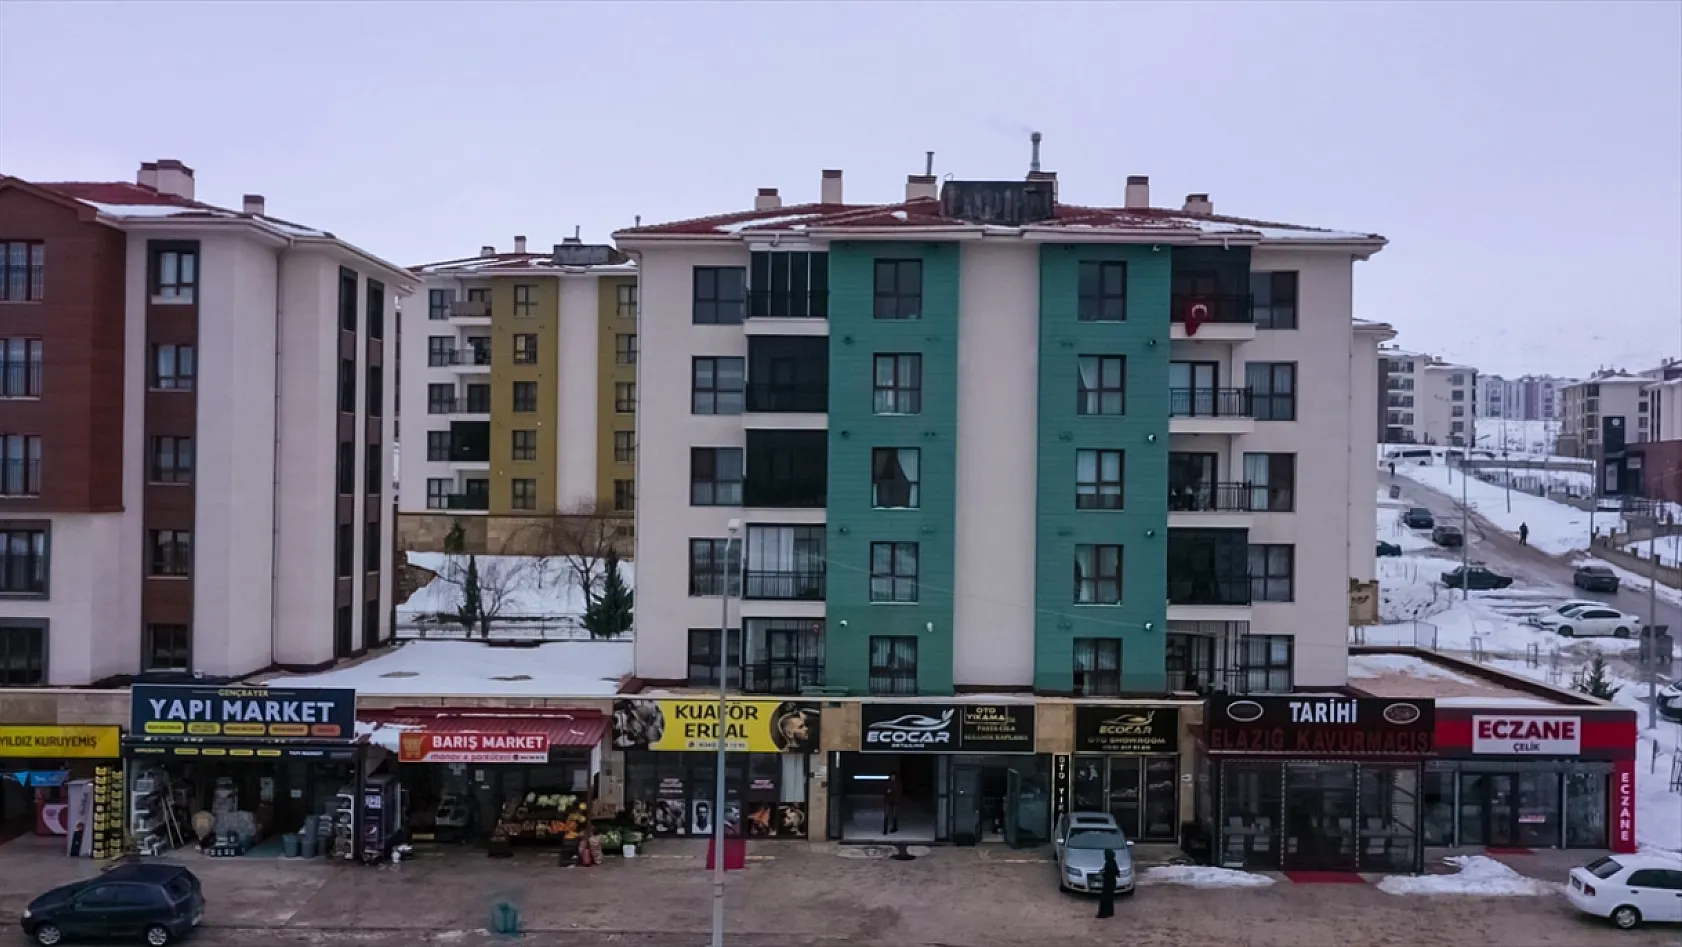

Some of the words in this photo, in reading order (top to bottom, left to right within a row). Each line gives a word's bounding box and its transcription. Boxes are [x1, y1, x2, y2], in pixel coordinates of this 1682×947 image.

[149, 698, 212, 720] YAPI
[222, 700, 336, 722] MARKET
[975, 706, 997, 714] OTO
[1289, 698, 1358, 723] TARİHİ
[684, 723, 749, 738] ERDAL
[866, 731, 950, 744] ECOCAR
[1099, 725, 1153, 734] ECOCAR
[1478, 720, 1576, 740] ECZANE
[0, 736, 32, 748] YILDIZ
[35, 734, 98, 750] KURUYEMİŞ
[432, 735, 478, 751] BARIŞ
[482, 736, 544, 749] MARKET
[1513, 743, 1541, 752] ÇELİK
[1620, 772, 1631, 842] ECZANE
